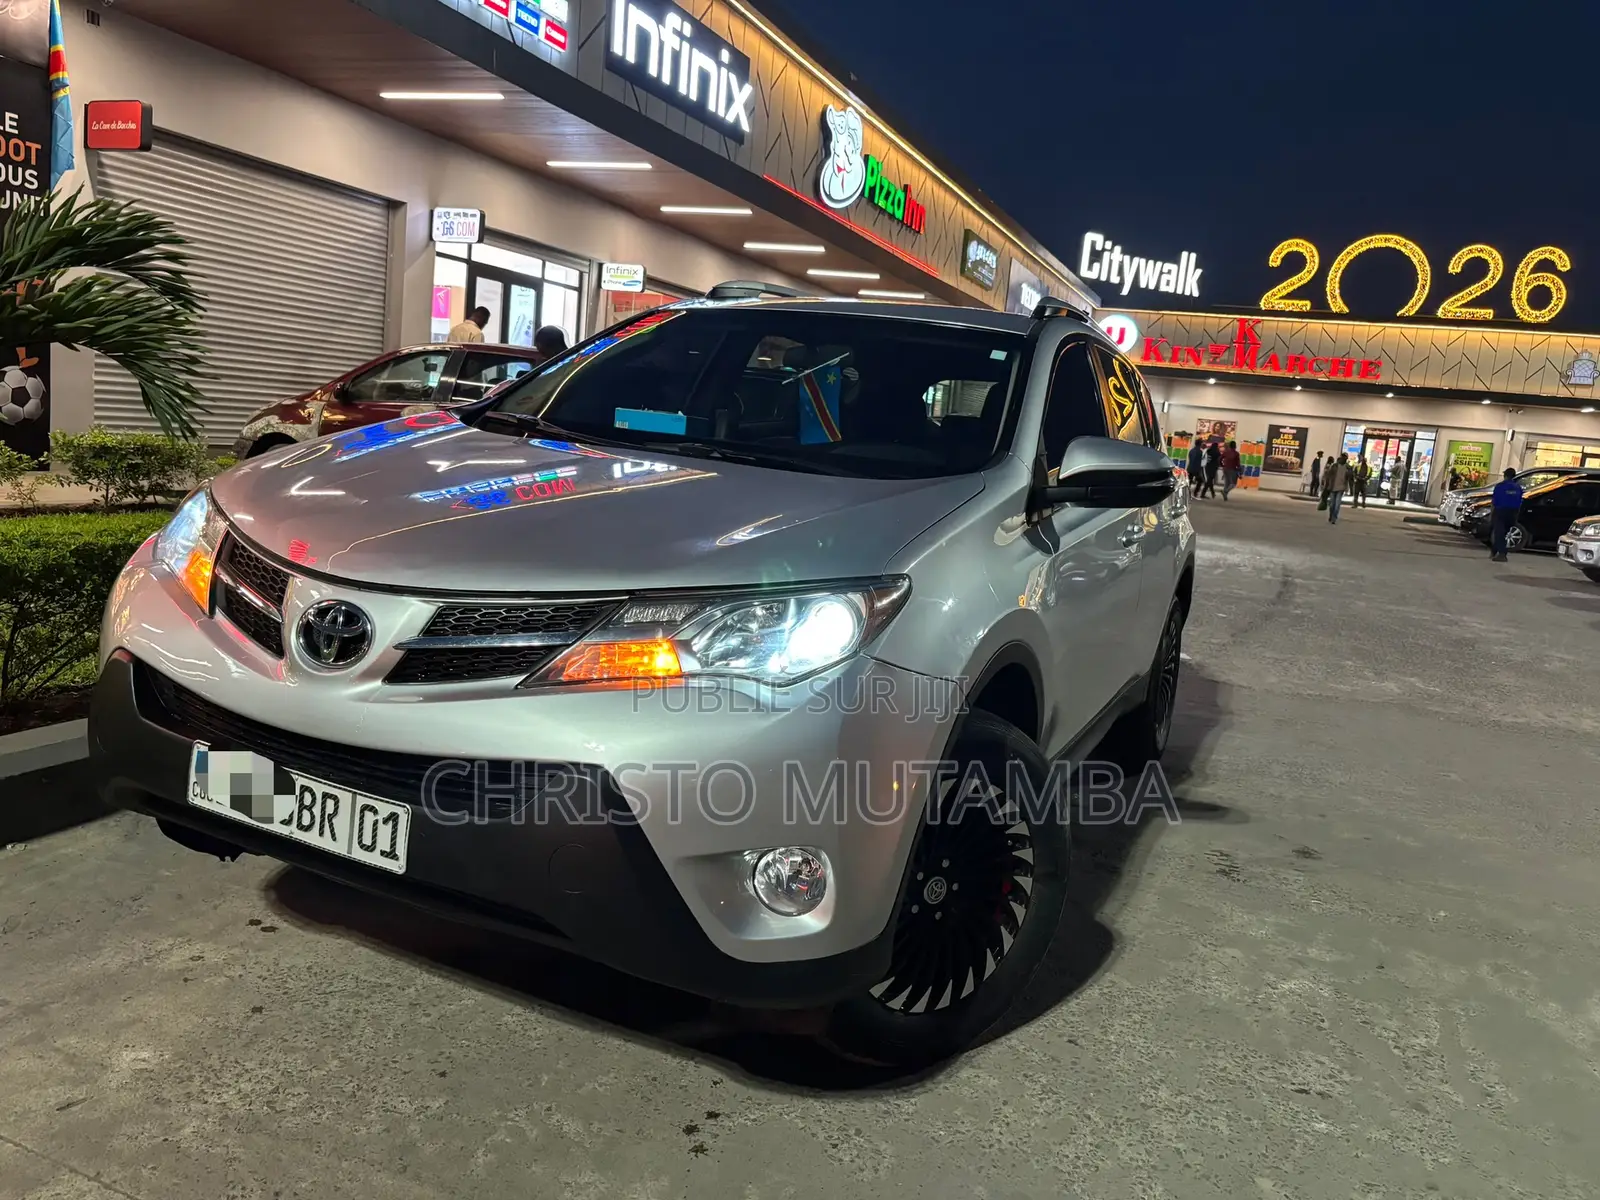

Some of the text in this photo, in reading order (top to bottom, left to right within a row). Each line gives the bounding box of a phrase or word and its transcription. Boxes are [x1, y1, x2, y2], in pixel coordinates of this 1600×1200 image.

[612, 0, 753, 133] Infinix
[864, 154, 926, 235] Pizza Inn
[456, 221, 476, 237] COM
[606, 266, 639, 276] Infinix
[1080, 231, 1203, 297] Citywalk
[1260, 234, 1571, 323] 2026
[1448, 459, 1489, 468] SSIETTE
[356, 802, 401, 861] 01
